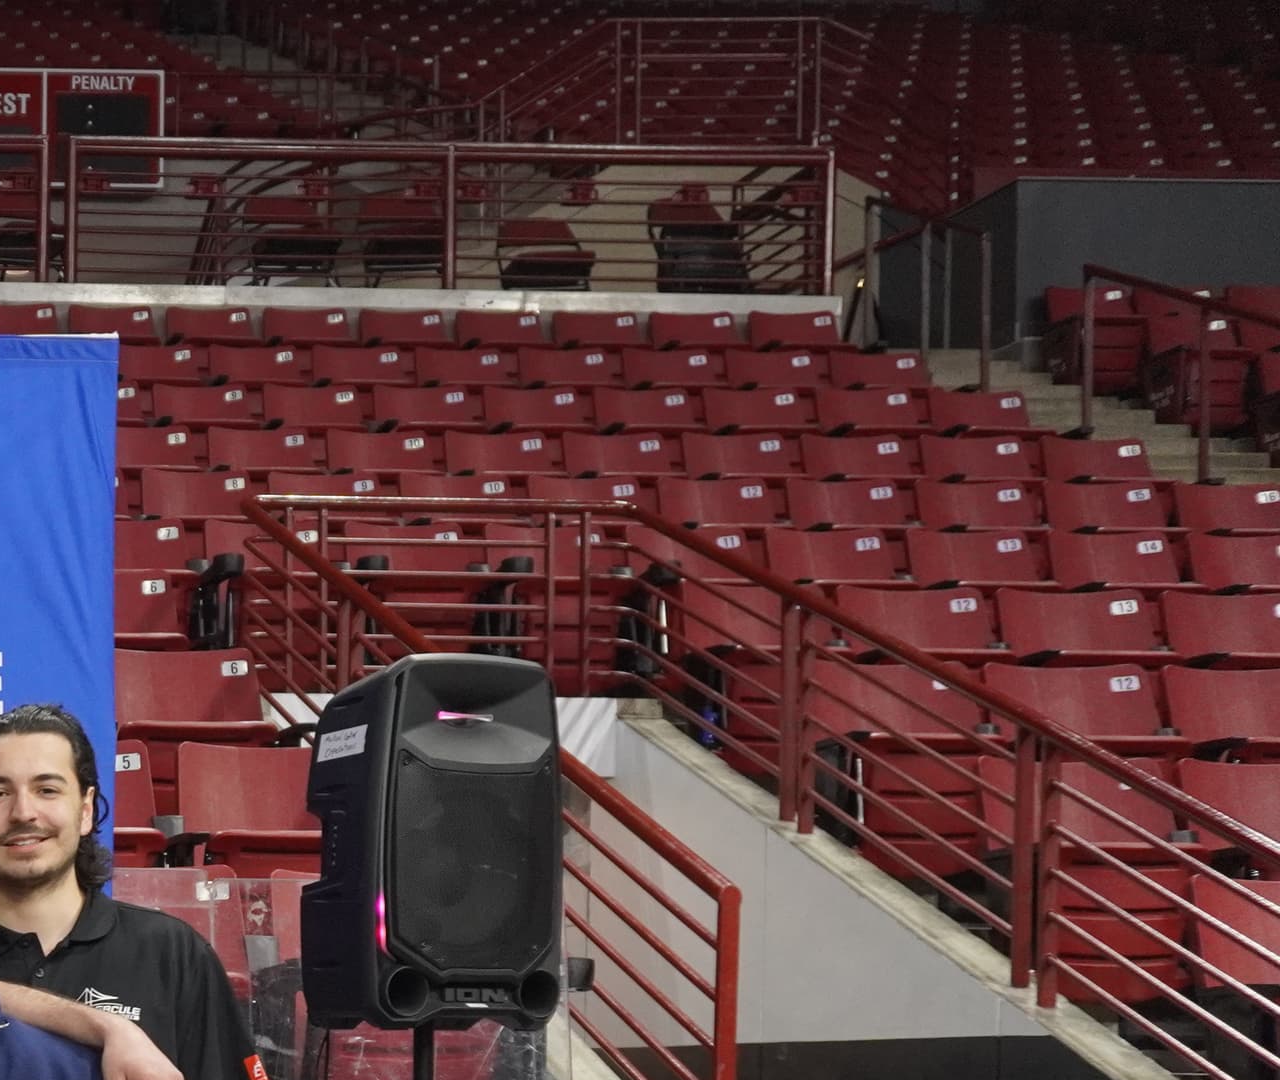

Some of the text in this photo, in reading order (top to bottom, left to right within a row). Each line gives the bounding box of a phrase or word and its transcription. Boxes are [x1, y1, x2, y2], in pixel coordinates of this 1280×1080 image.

[71, 75, 135, 91] PENALTY
[338, 393, 350, 401] 10
[449, 393, 461, 402] 11
[559, 394, 571, 403] 12
[408, 438, 420, 448] 10
[528, 440, 538, 450] 11
[644, 441, 657, 450] 12
[765, 441, 777, 451] 13
[882, 443, 894, 453] 14
[1125, 446, 1138, 456] 16
[488, 483, 501, 493] 10
[619, 486, 630, 496] 11
[745, 487, 758, 497] 12
[876, 488, 889, 498] 13
[1002, 490, 1015, 500] 14
[1134, 490, 1145, 500] 15
[1263, 492, 1276, 502] 16
[723, 536, 735, 547] 11
[861, 539, 874, 549] 12
[1002, 540, 1016, 551] 13
[1145, 541, 1157, 552] 14
[956, 600, 971, 611] 12
[1118, 601, 1132, 613] 13
[1117, 678, 1133, 690] 12
[444, 988, 505, 1002] ION
